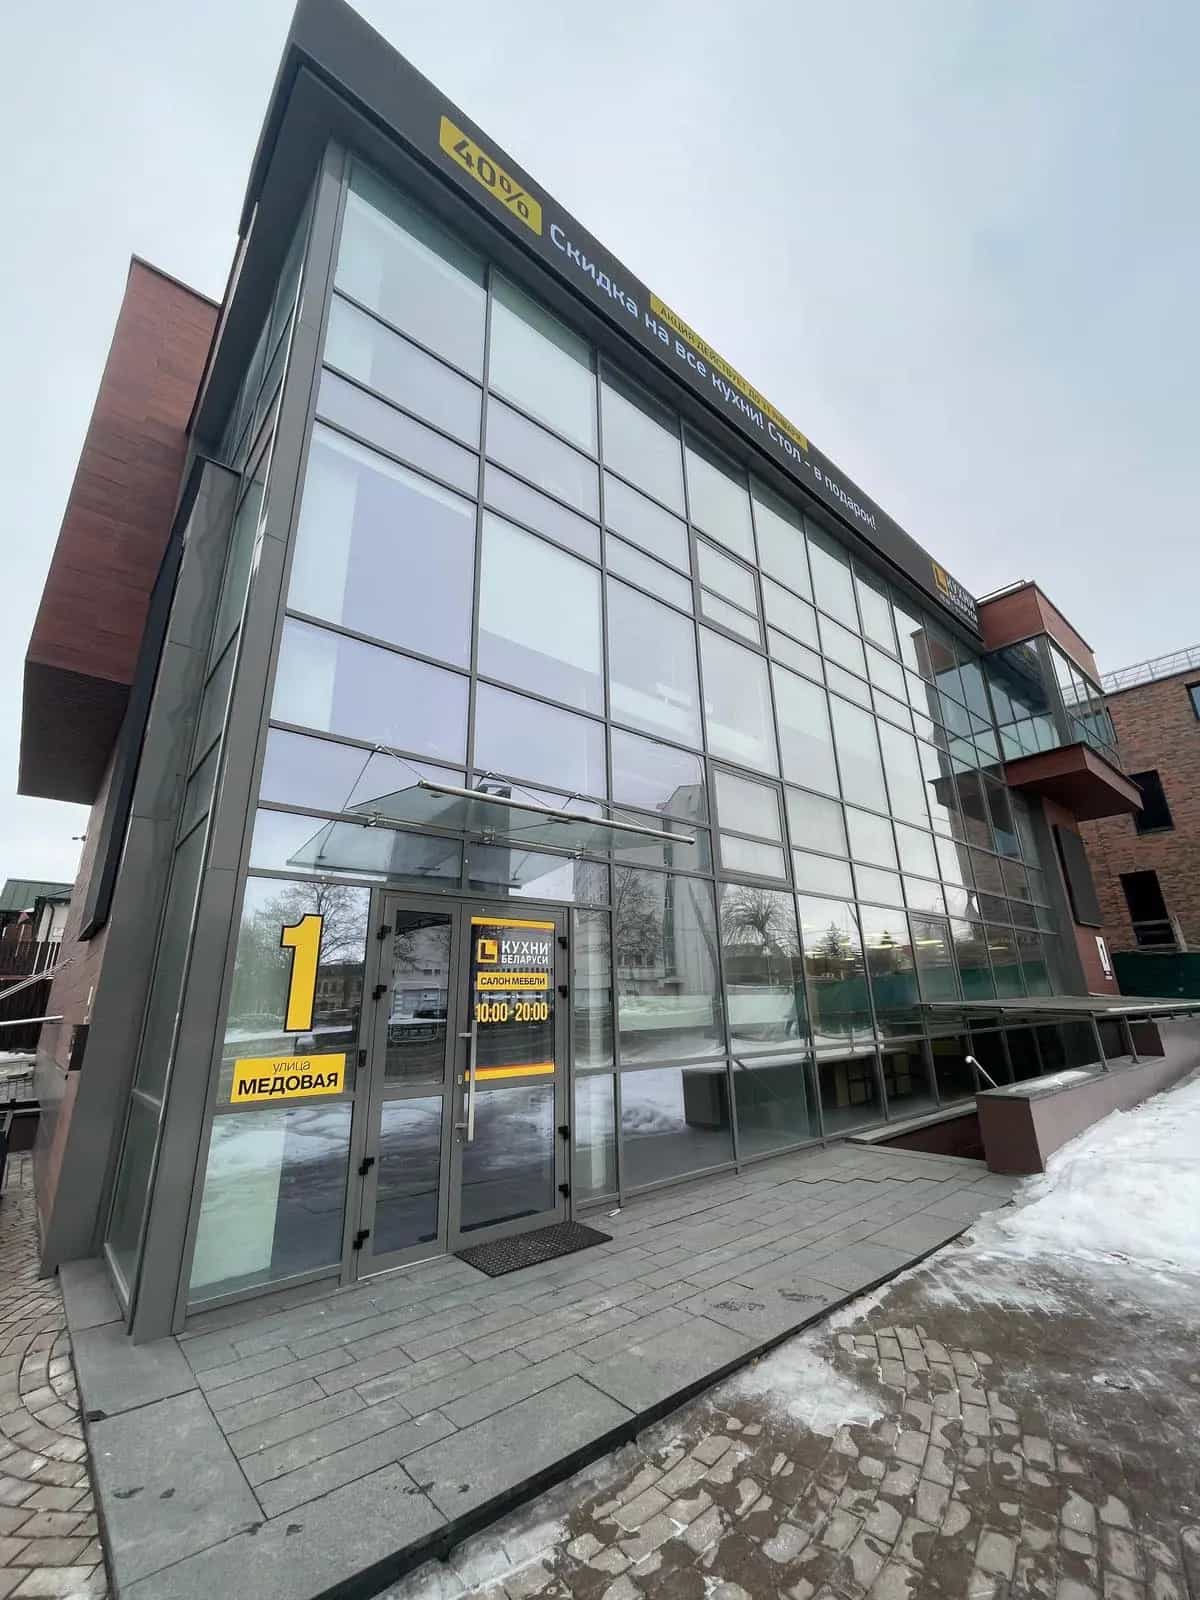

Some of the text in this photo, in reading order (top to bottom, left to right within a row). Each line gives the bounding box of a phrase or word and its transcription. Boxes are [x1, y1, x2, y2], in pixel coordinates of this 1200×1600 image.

[453, 139, 529, 219] 40%
[550, 224, 638, 318] Скидка
[645, 313, 670, 346] на
[675, 340, 706, 378] все
[712, 373, 764, 430] кухни!
[768, 422, 801, 463] Стол
[814, 465, 822, 481] в
[824, 476, 877, 531] подарок!
[501, 940, 548, 955] КУХНИ
[501, 954, 548, 965] БЕЛАРУСИ
[280, 914, 324, 1033] 1
[480, 977, 545, 985] САЛОН МЕБЕЛИ
[273, 1060, 312, 1073] улица
[238, 1072, 339, 1096] МЕДОВАЯ
